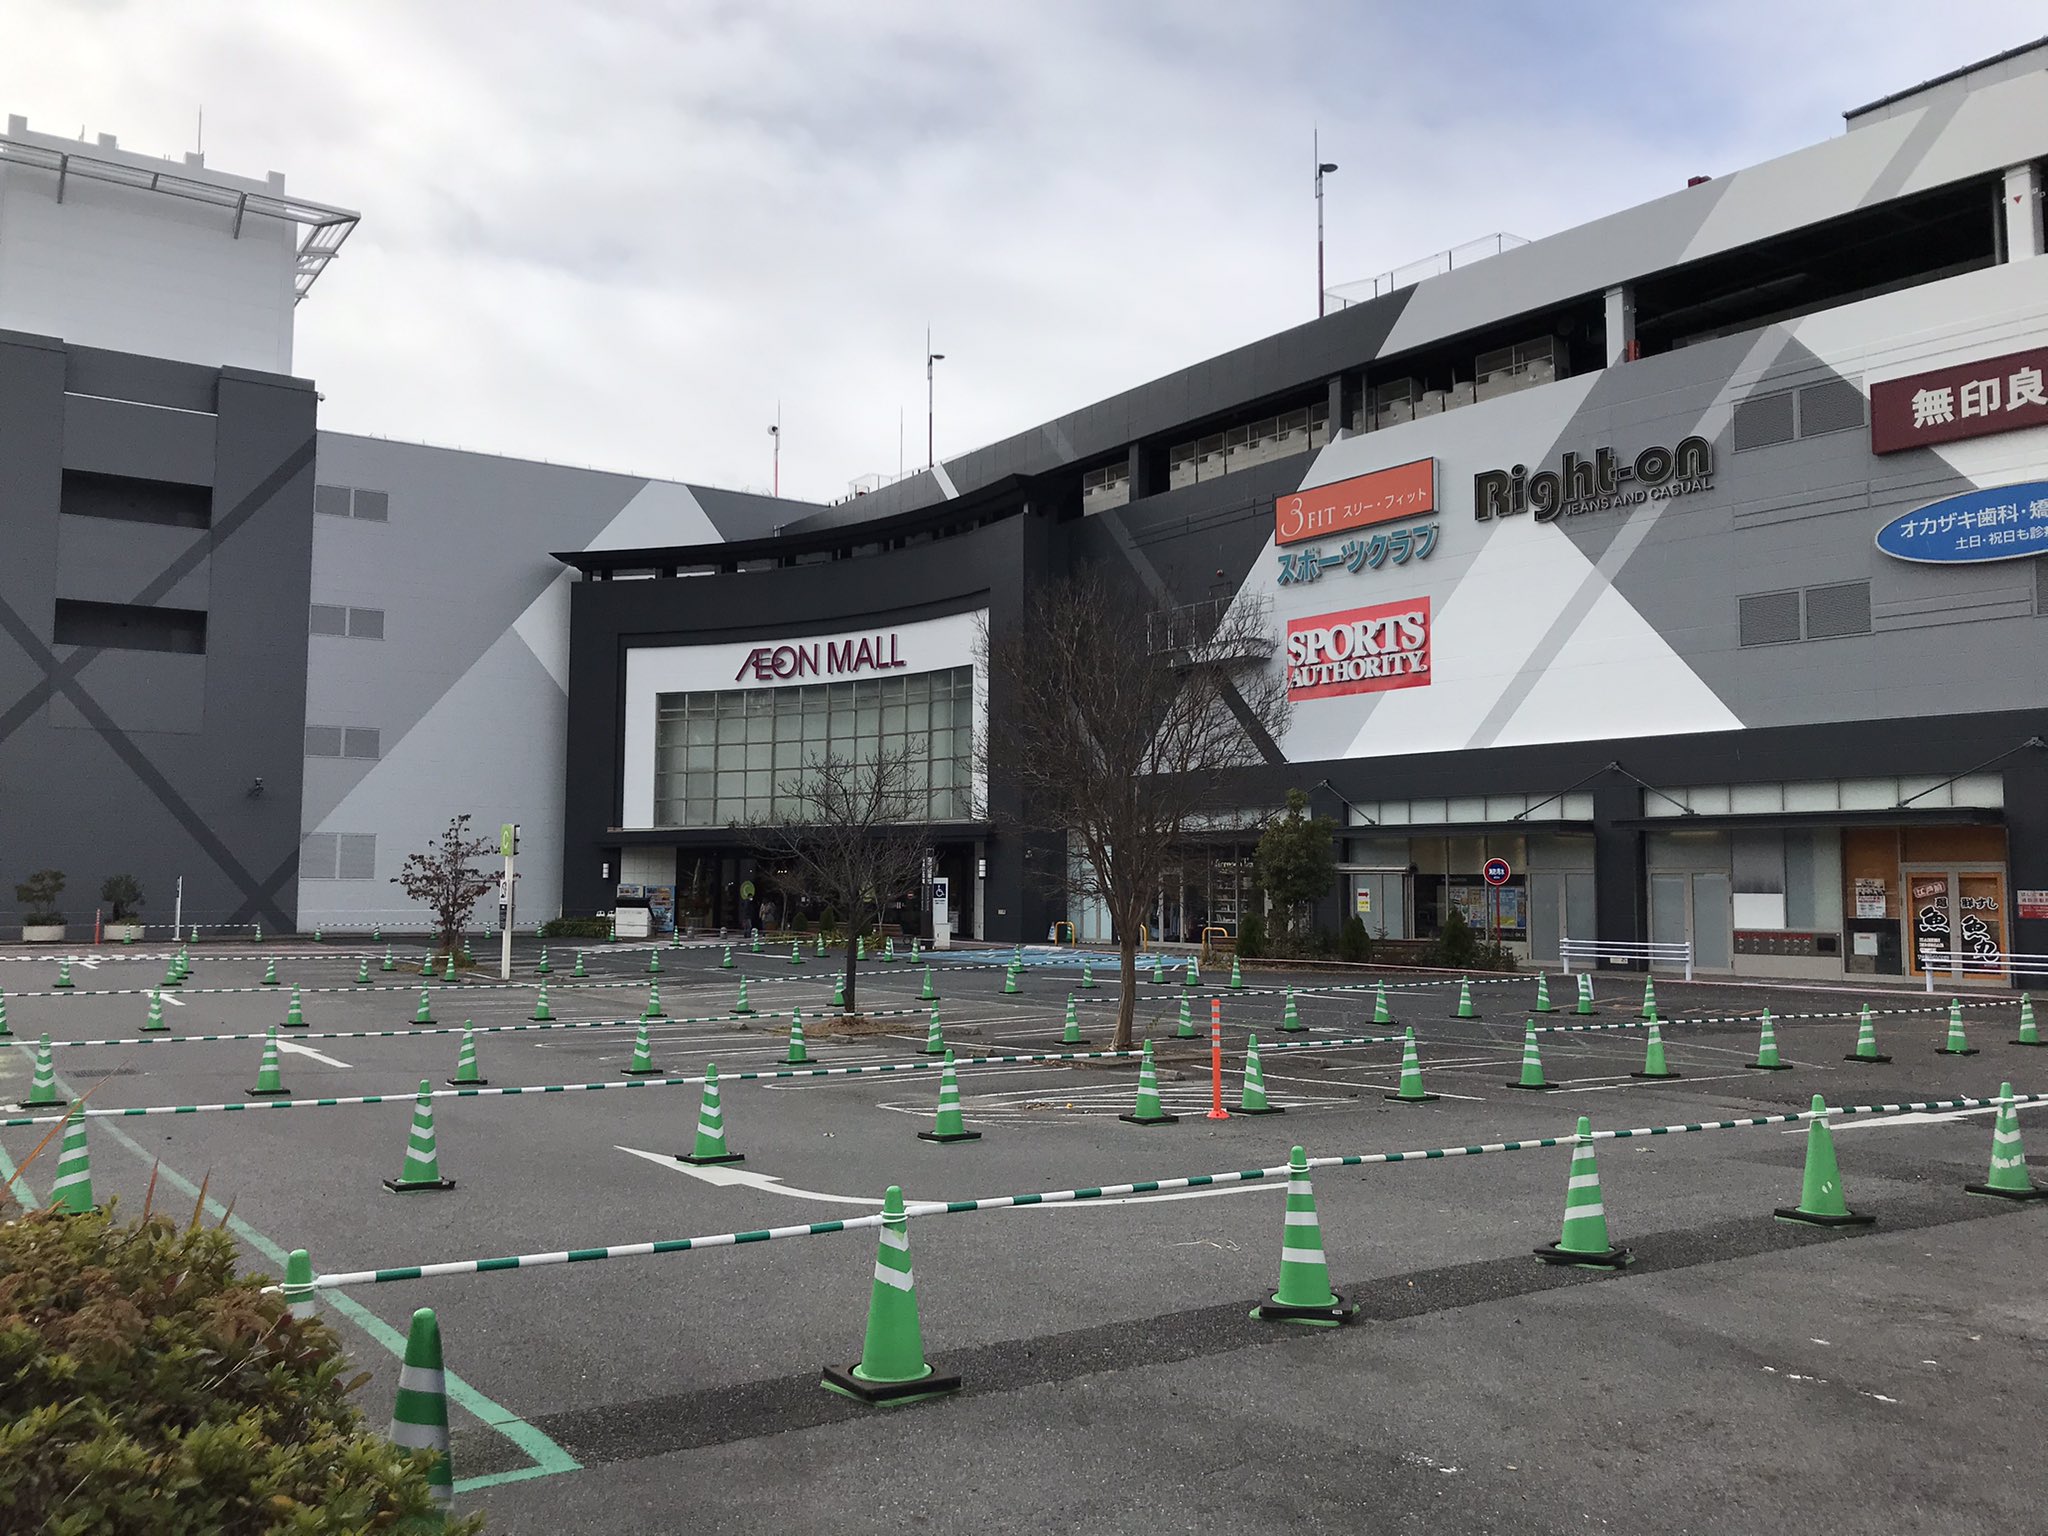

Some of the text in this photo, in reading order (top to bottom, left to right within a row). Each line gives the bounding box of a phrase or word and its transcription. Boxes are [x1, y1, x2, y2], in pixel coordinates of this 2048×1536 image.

[1912, 367, 2048, 429] 無印良
[1474, 436, 1714, 522] Right-on
[1564, 476, 1715, 518] JEANS AND CASUAL
[1277, 522, 1440, 586] スポーツクラブ
[827, 633, 907, 675] MALL
[1288, 612, 1426, 668] SPORTS
